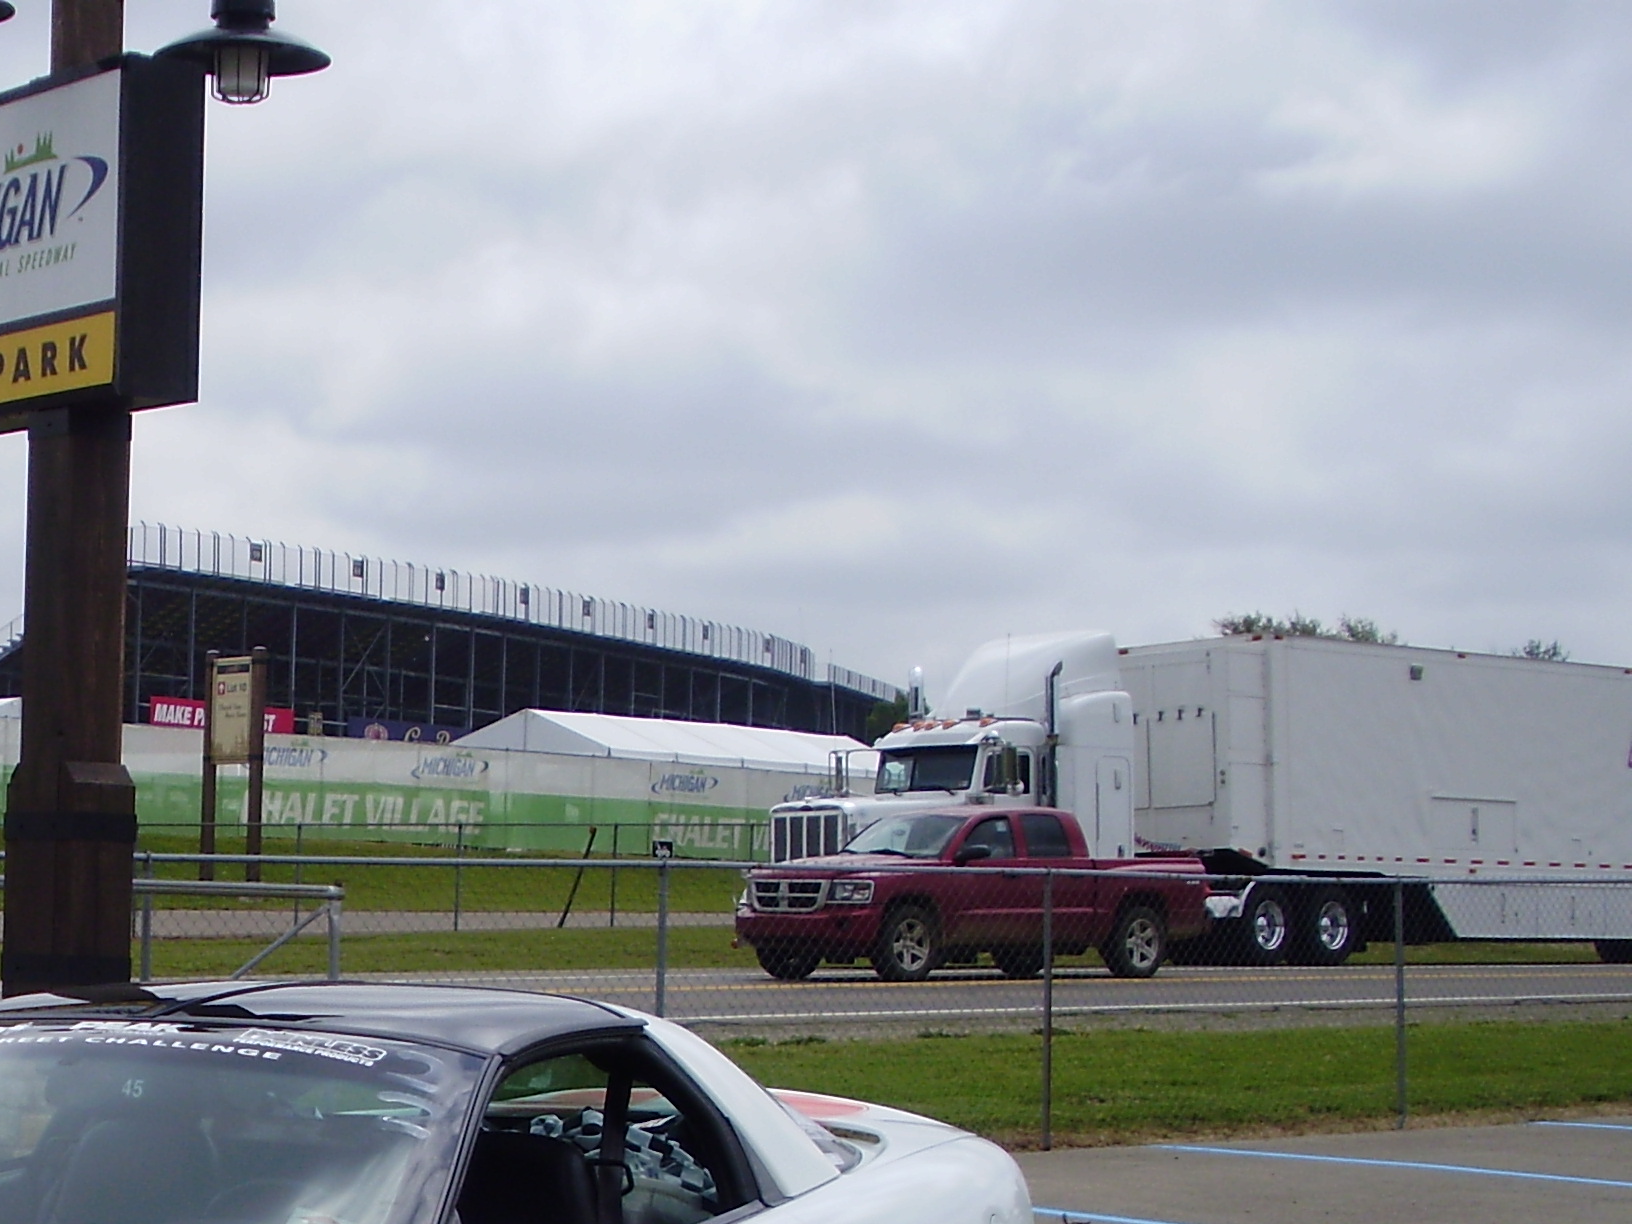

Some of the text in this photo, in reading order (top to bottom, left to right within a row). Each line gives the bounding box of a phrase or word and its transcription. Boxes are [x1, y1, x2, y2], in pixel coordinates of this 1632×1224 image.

[17, 243, 77, 274] SPEEDWAY
[154, 703, 193, 725] MAKE
[421, 757, 476, 777] MICHIGAN
[659, 774, 708, 793] MICHIGAN
[366, 792, 485, 834] VILLAGE
[652, 812, 747, 849] CHALET
[69, 1021, 194, 1034] PEAK
[85, 1037, 282, 1060] CHALLENGE
[121, 1080, 145, 1098] 45
